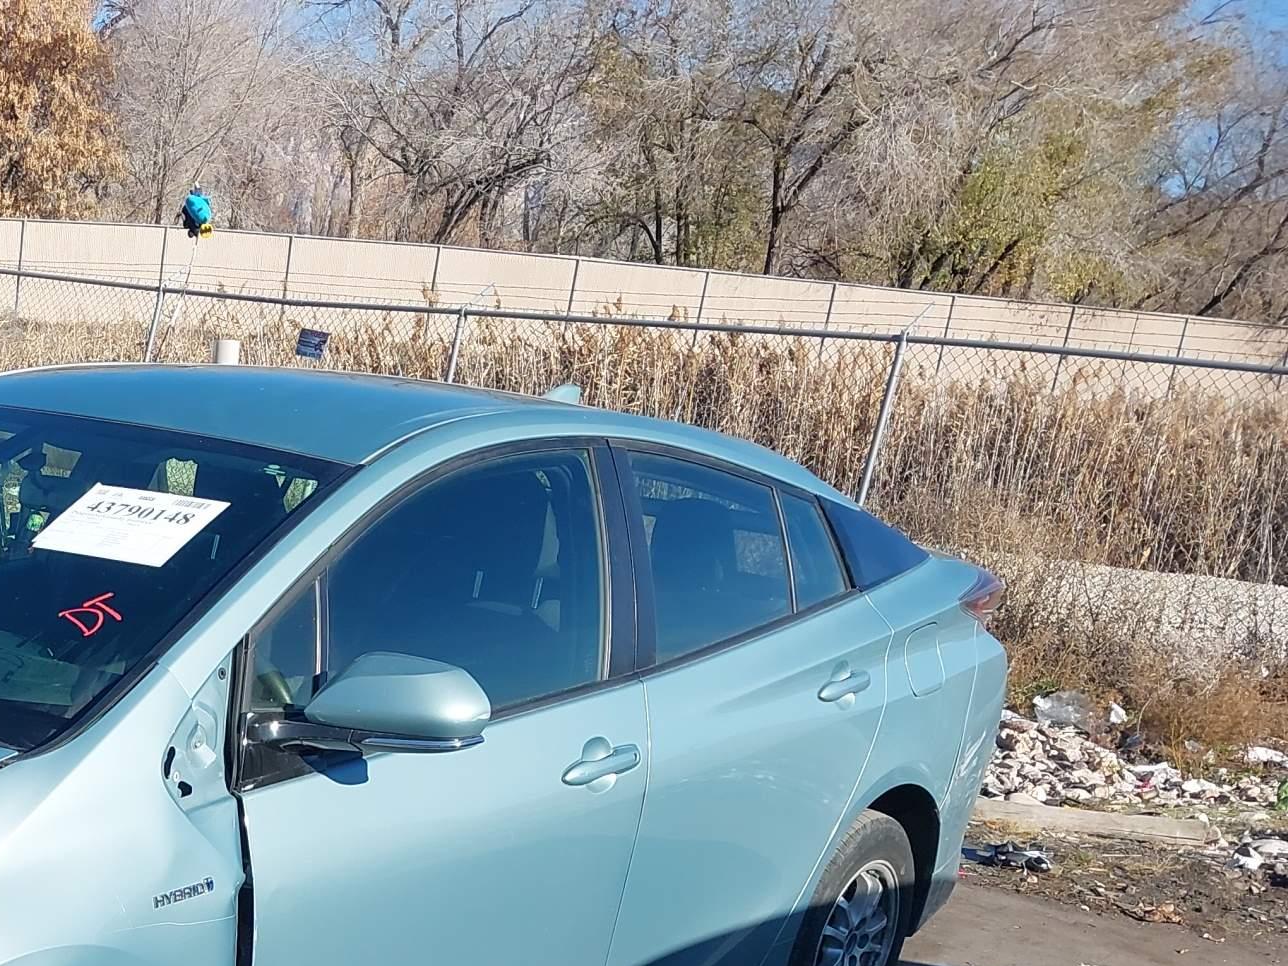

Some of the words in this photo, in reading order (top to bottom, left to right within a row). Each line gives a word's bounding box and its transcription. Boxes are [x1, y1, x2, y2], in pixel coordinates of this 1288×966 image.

[87, 500, 196, 525] 43790148
[58, 593, 122, 637] DT
[153, 882, 205, 909] HYBRID
